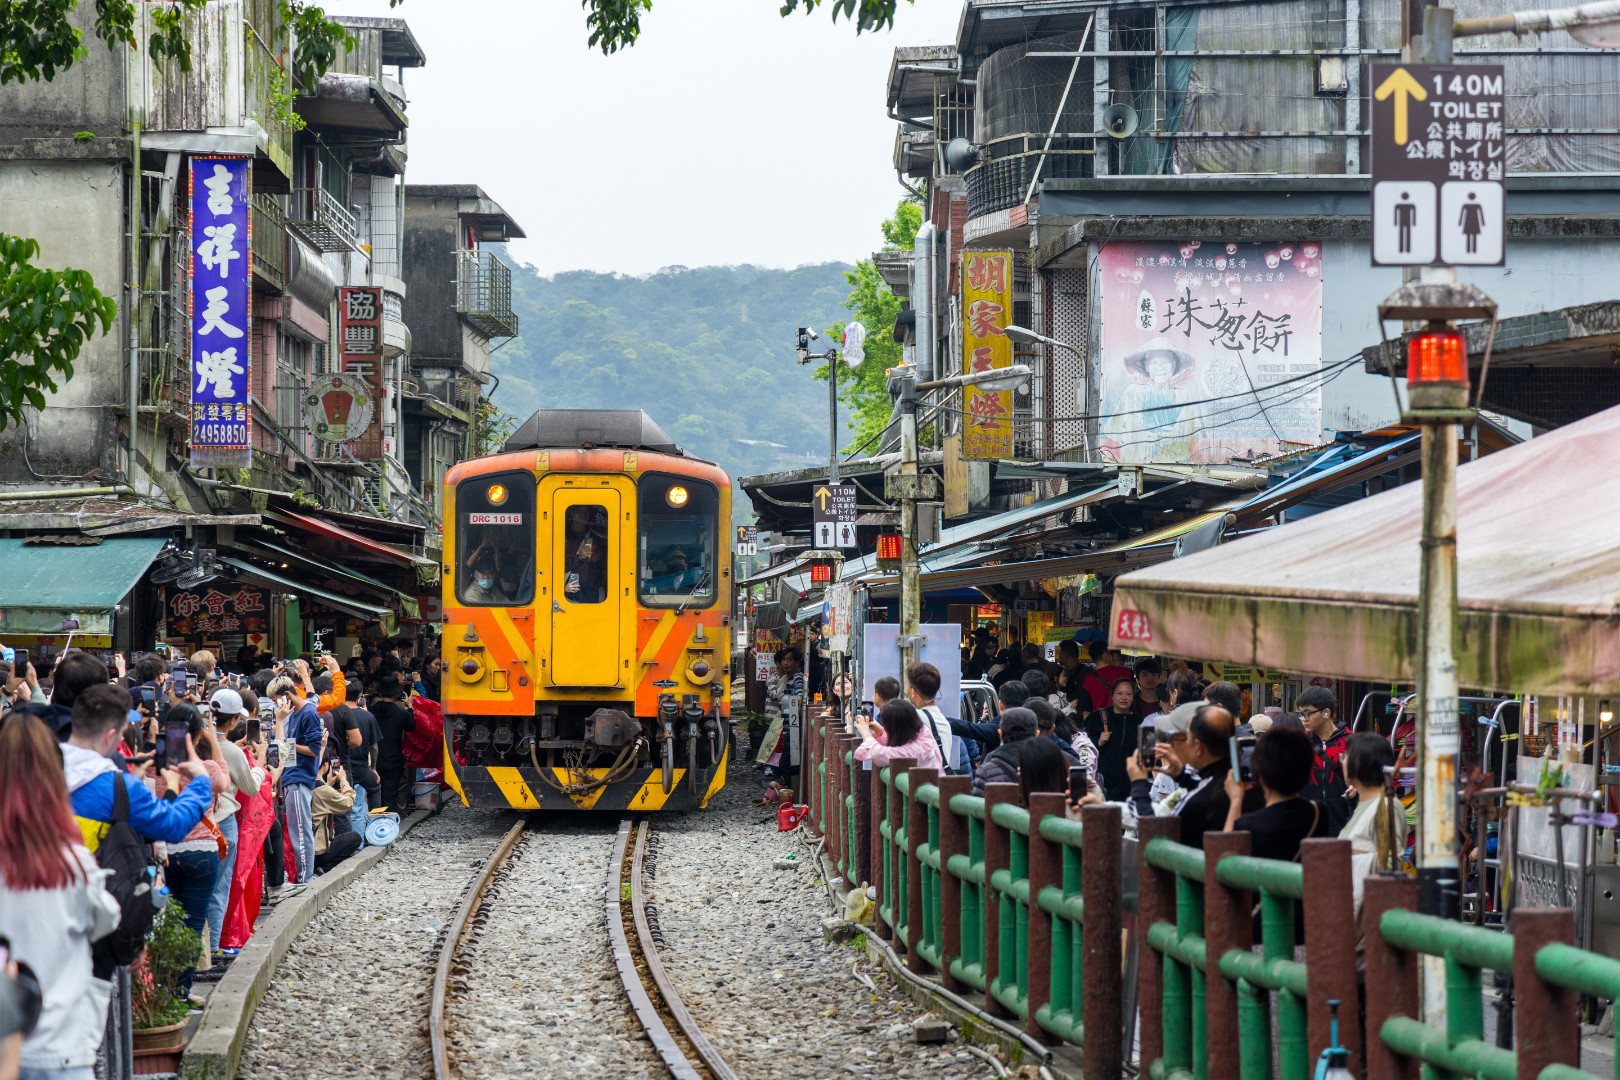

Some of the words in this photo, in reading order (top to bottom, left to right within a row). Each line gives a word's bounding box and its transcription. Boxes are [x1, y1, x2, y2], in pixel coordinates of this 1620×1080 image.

[1433, 75, 1502, 95] 140M
[1430, 102, 1502, 118] TOILET
[1449, 161, 1502, 180] 화장실
[196, 164, 245, 398] 吉祥天燈
[194, 402, 246, 421] 批發零售
[194, 424, 246, 443] 24958850
[833, 488, 856, 496] 110M
[472, 515, 490, 523] DRC
[493, 515, 520, 523] 1016
[170, 590, 264, 616] 你會紅
[760, 642, 781, 653] TAXI
[791, 714, 797, 726] 2
